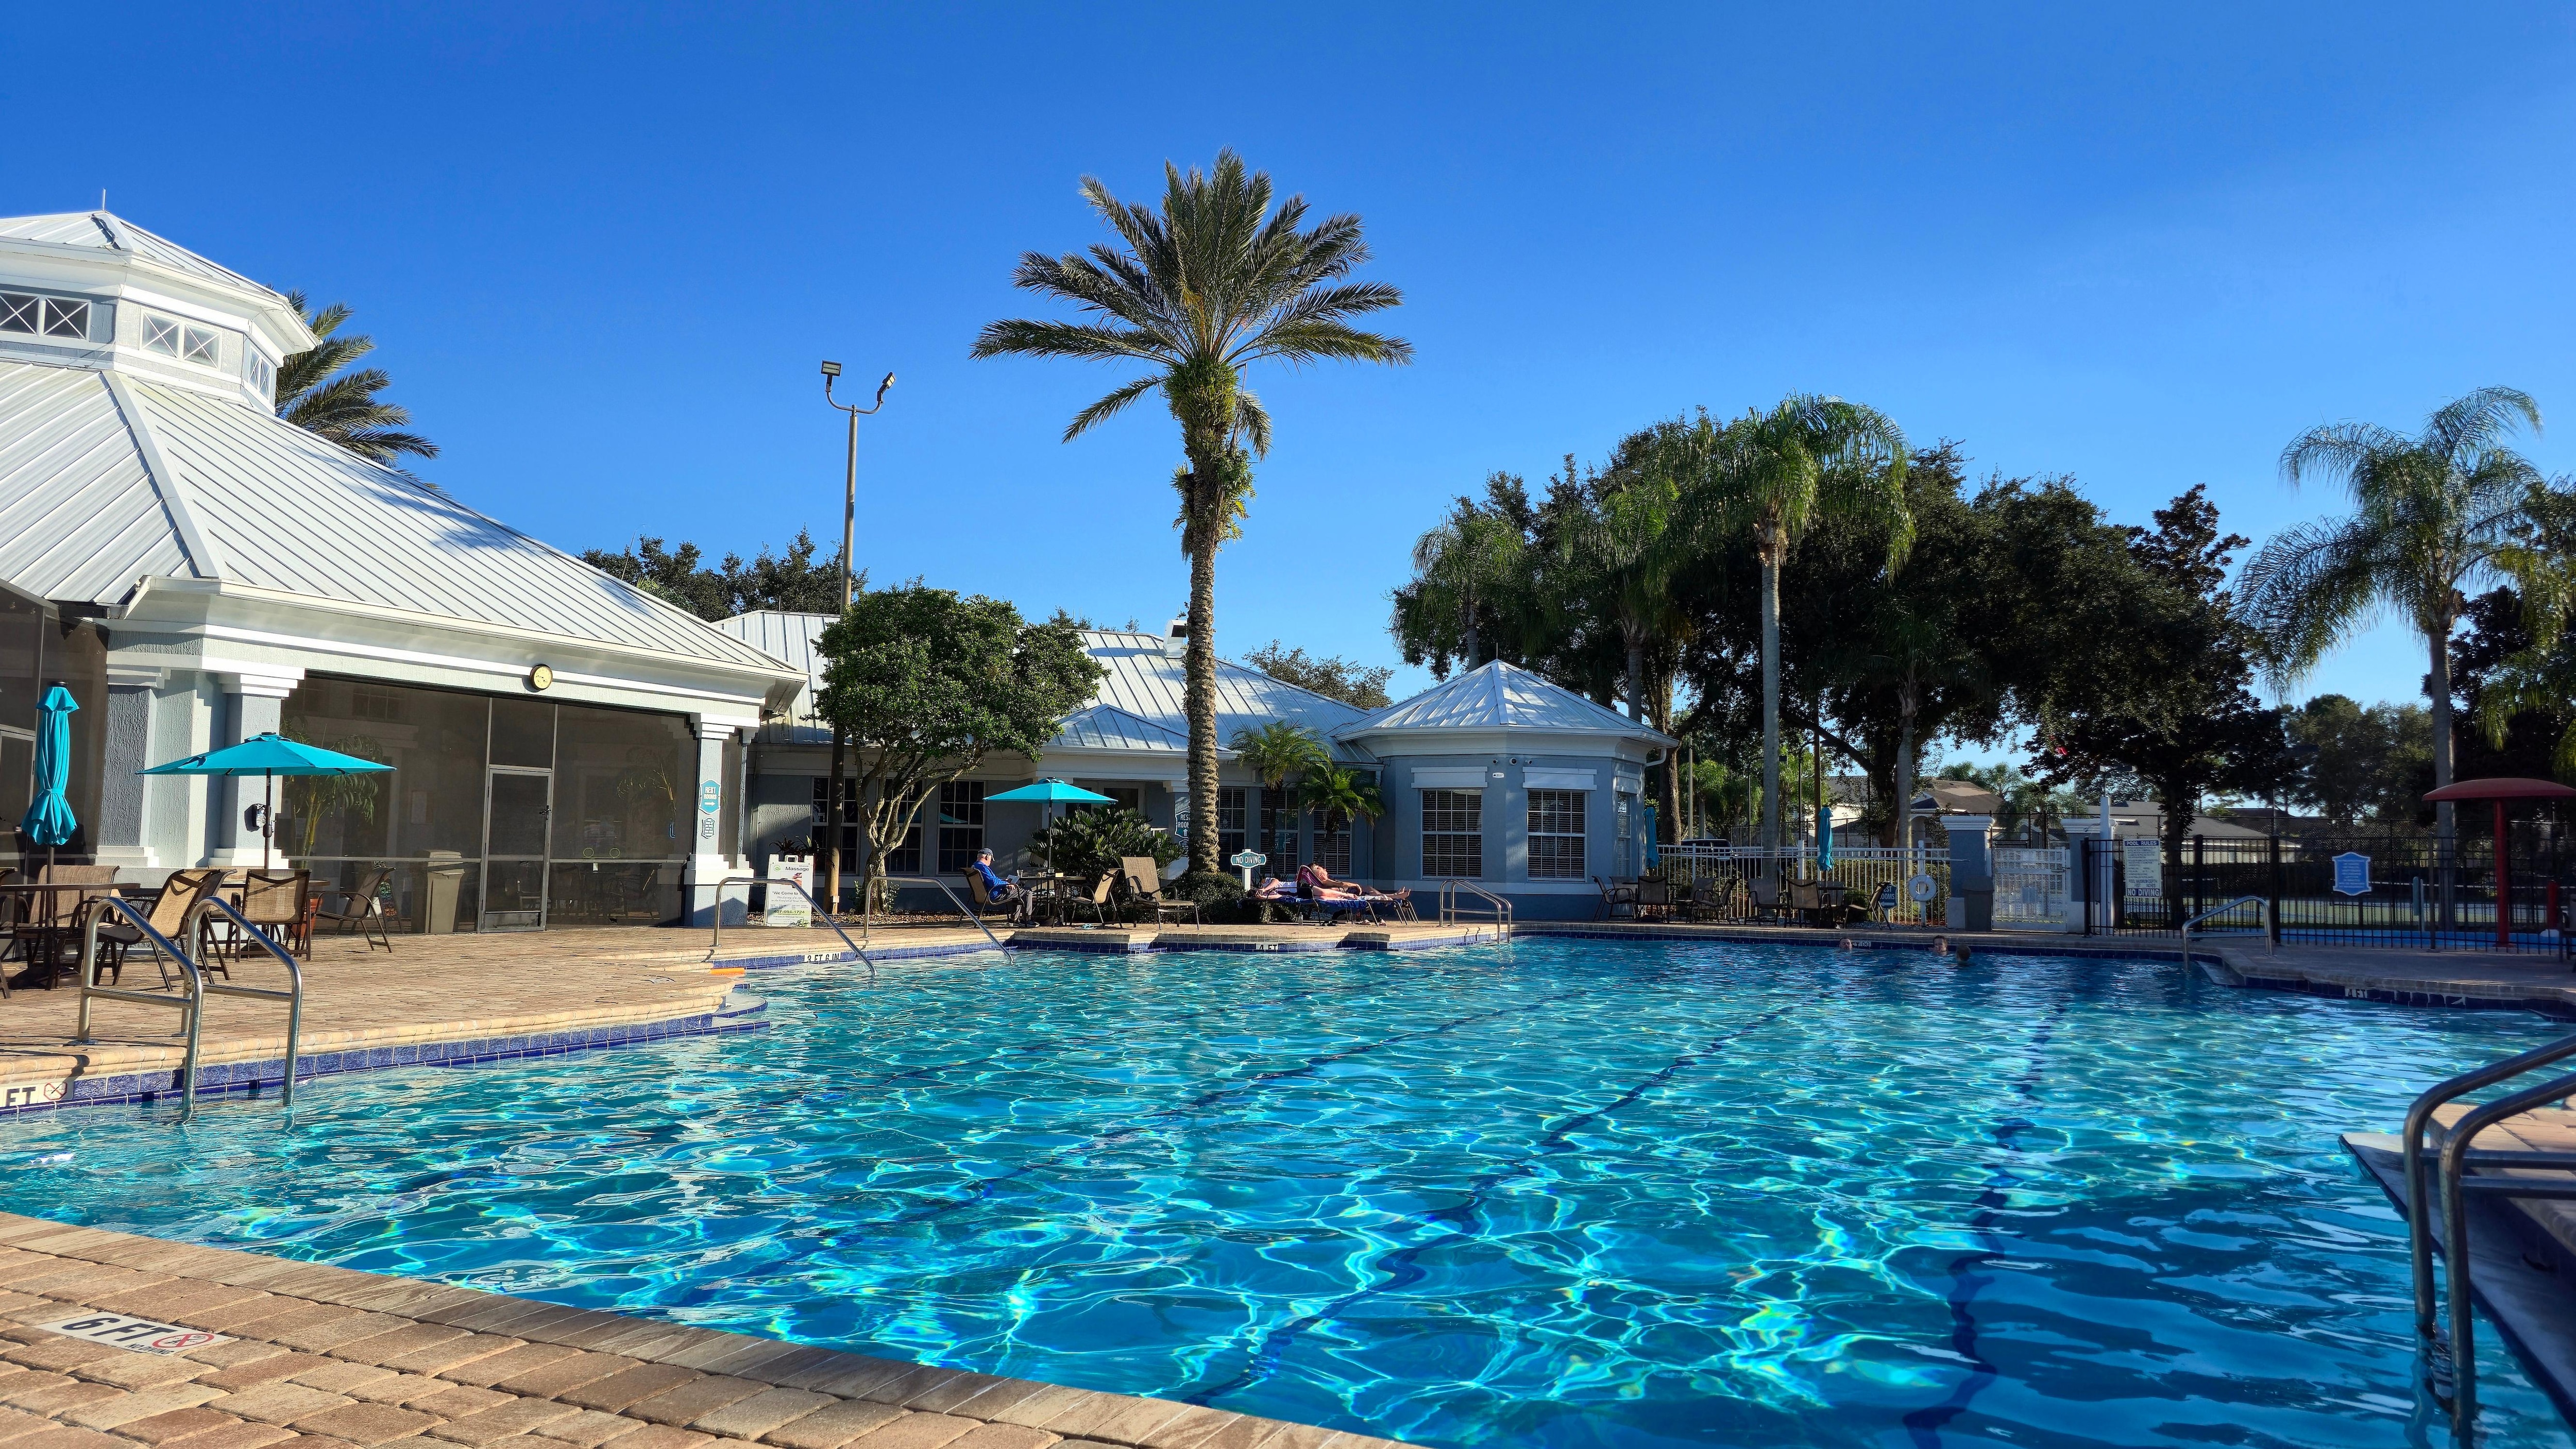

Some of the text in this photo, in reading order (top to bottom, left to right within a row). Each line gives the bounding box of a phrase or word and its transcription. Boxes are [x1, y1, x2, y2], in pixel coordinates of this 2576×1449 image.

[1245, 856, 1261, 864] DIVING
[2355, 989, 2365, 998] FT
[5, 1086, 36, 1107] FT
[61, 1318, 178, 1342] 6 FT
[138, 1346, 174, 1354] DIVING
